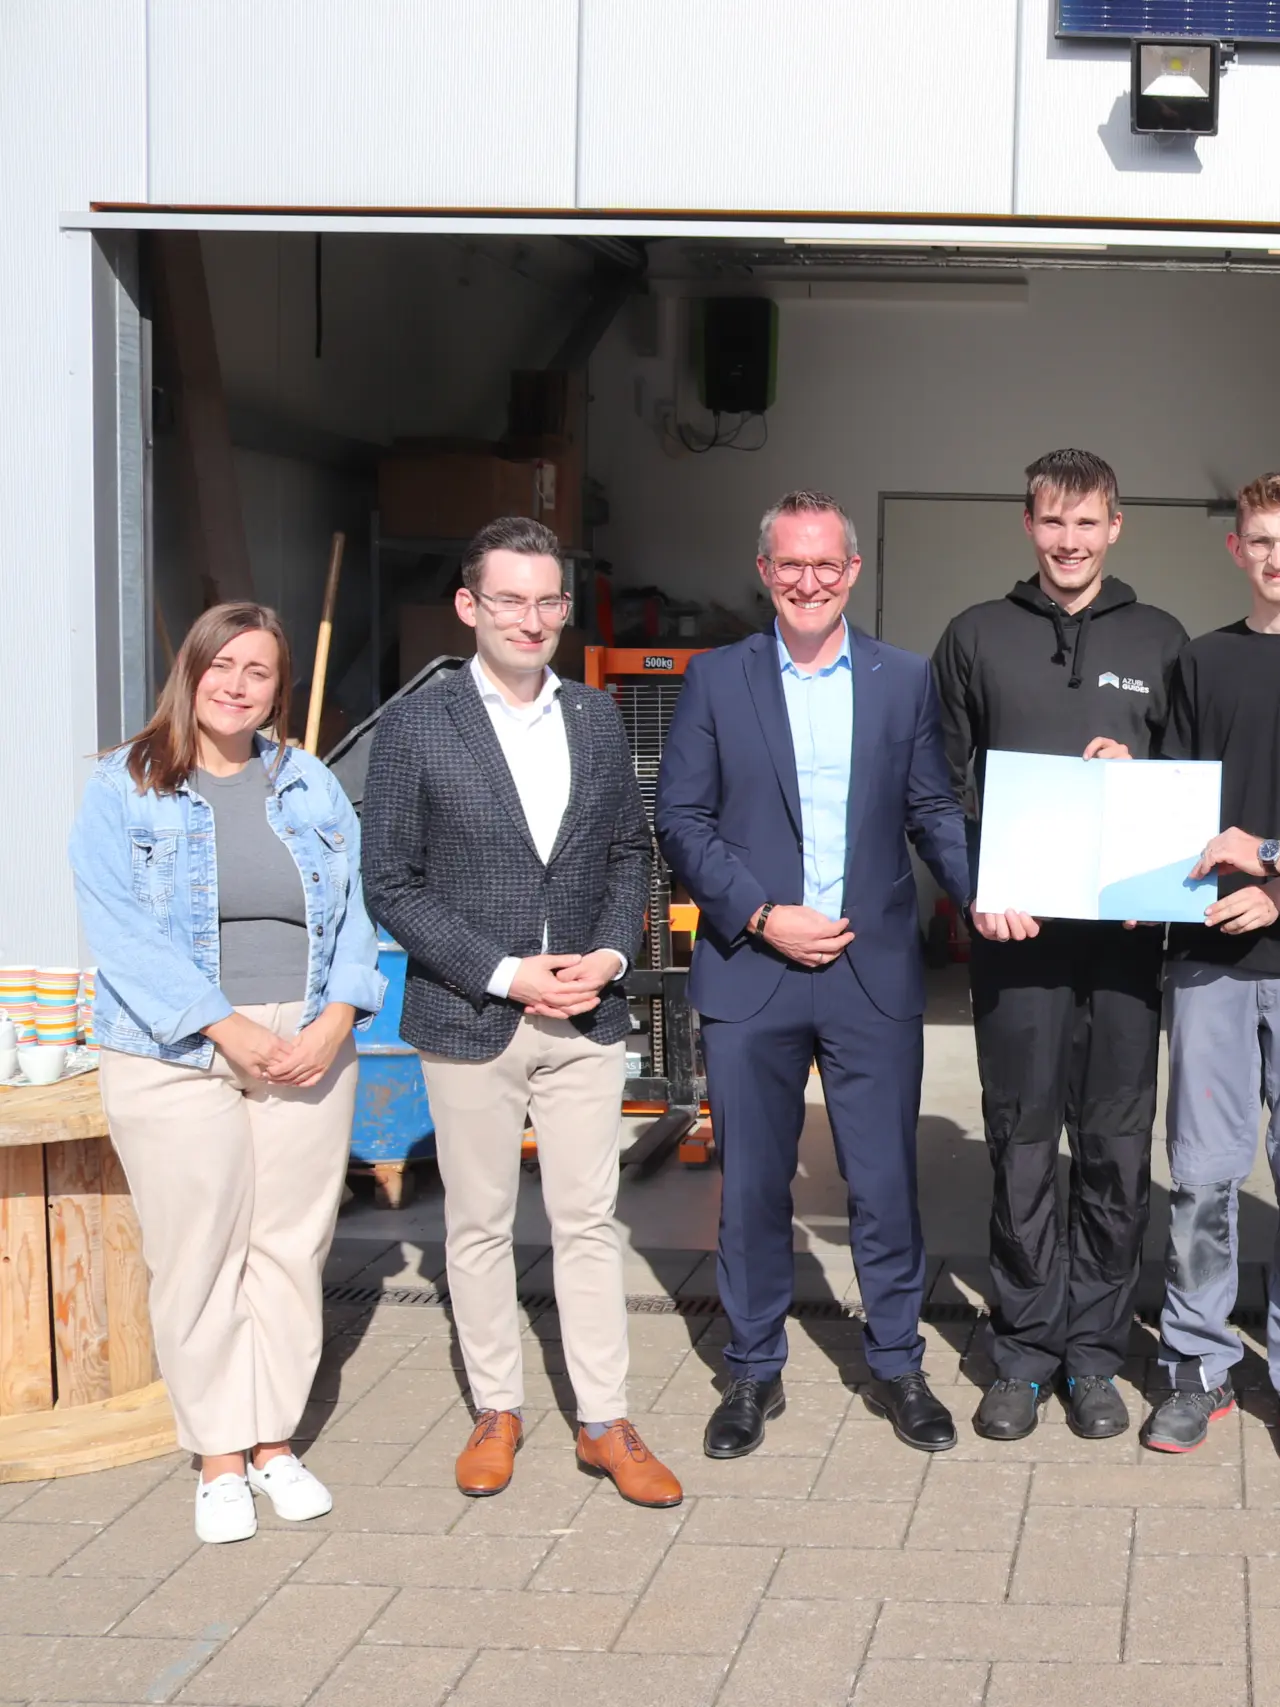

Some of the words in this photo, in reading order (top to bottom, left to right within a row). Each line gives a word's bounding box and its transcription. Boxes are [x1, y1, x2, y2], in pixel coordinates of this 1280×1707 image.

[645, 657, 673, 669] 500kg
[1122, 678, 1143, 686] AZUBI
[1122, 684, 1149, 693] GUIDES
